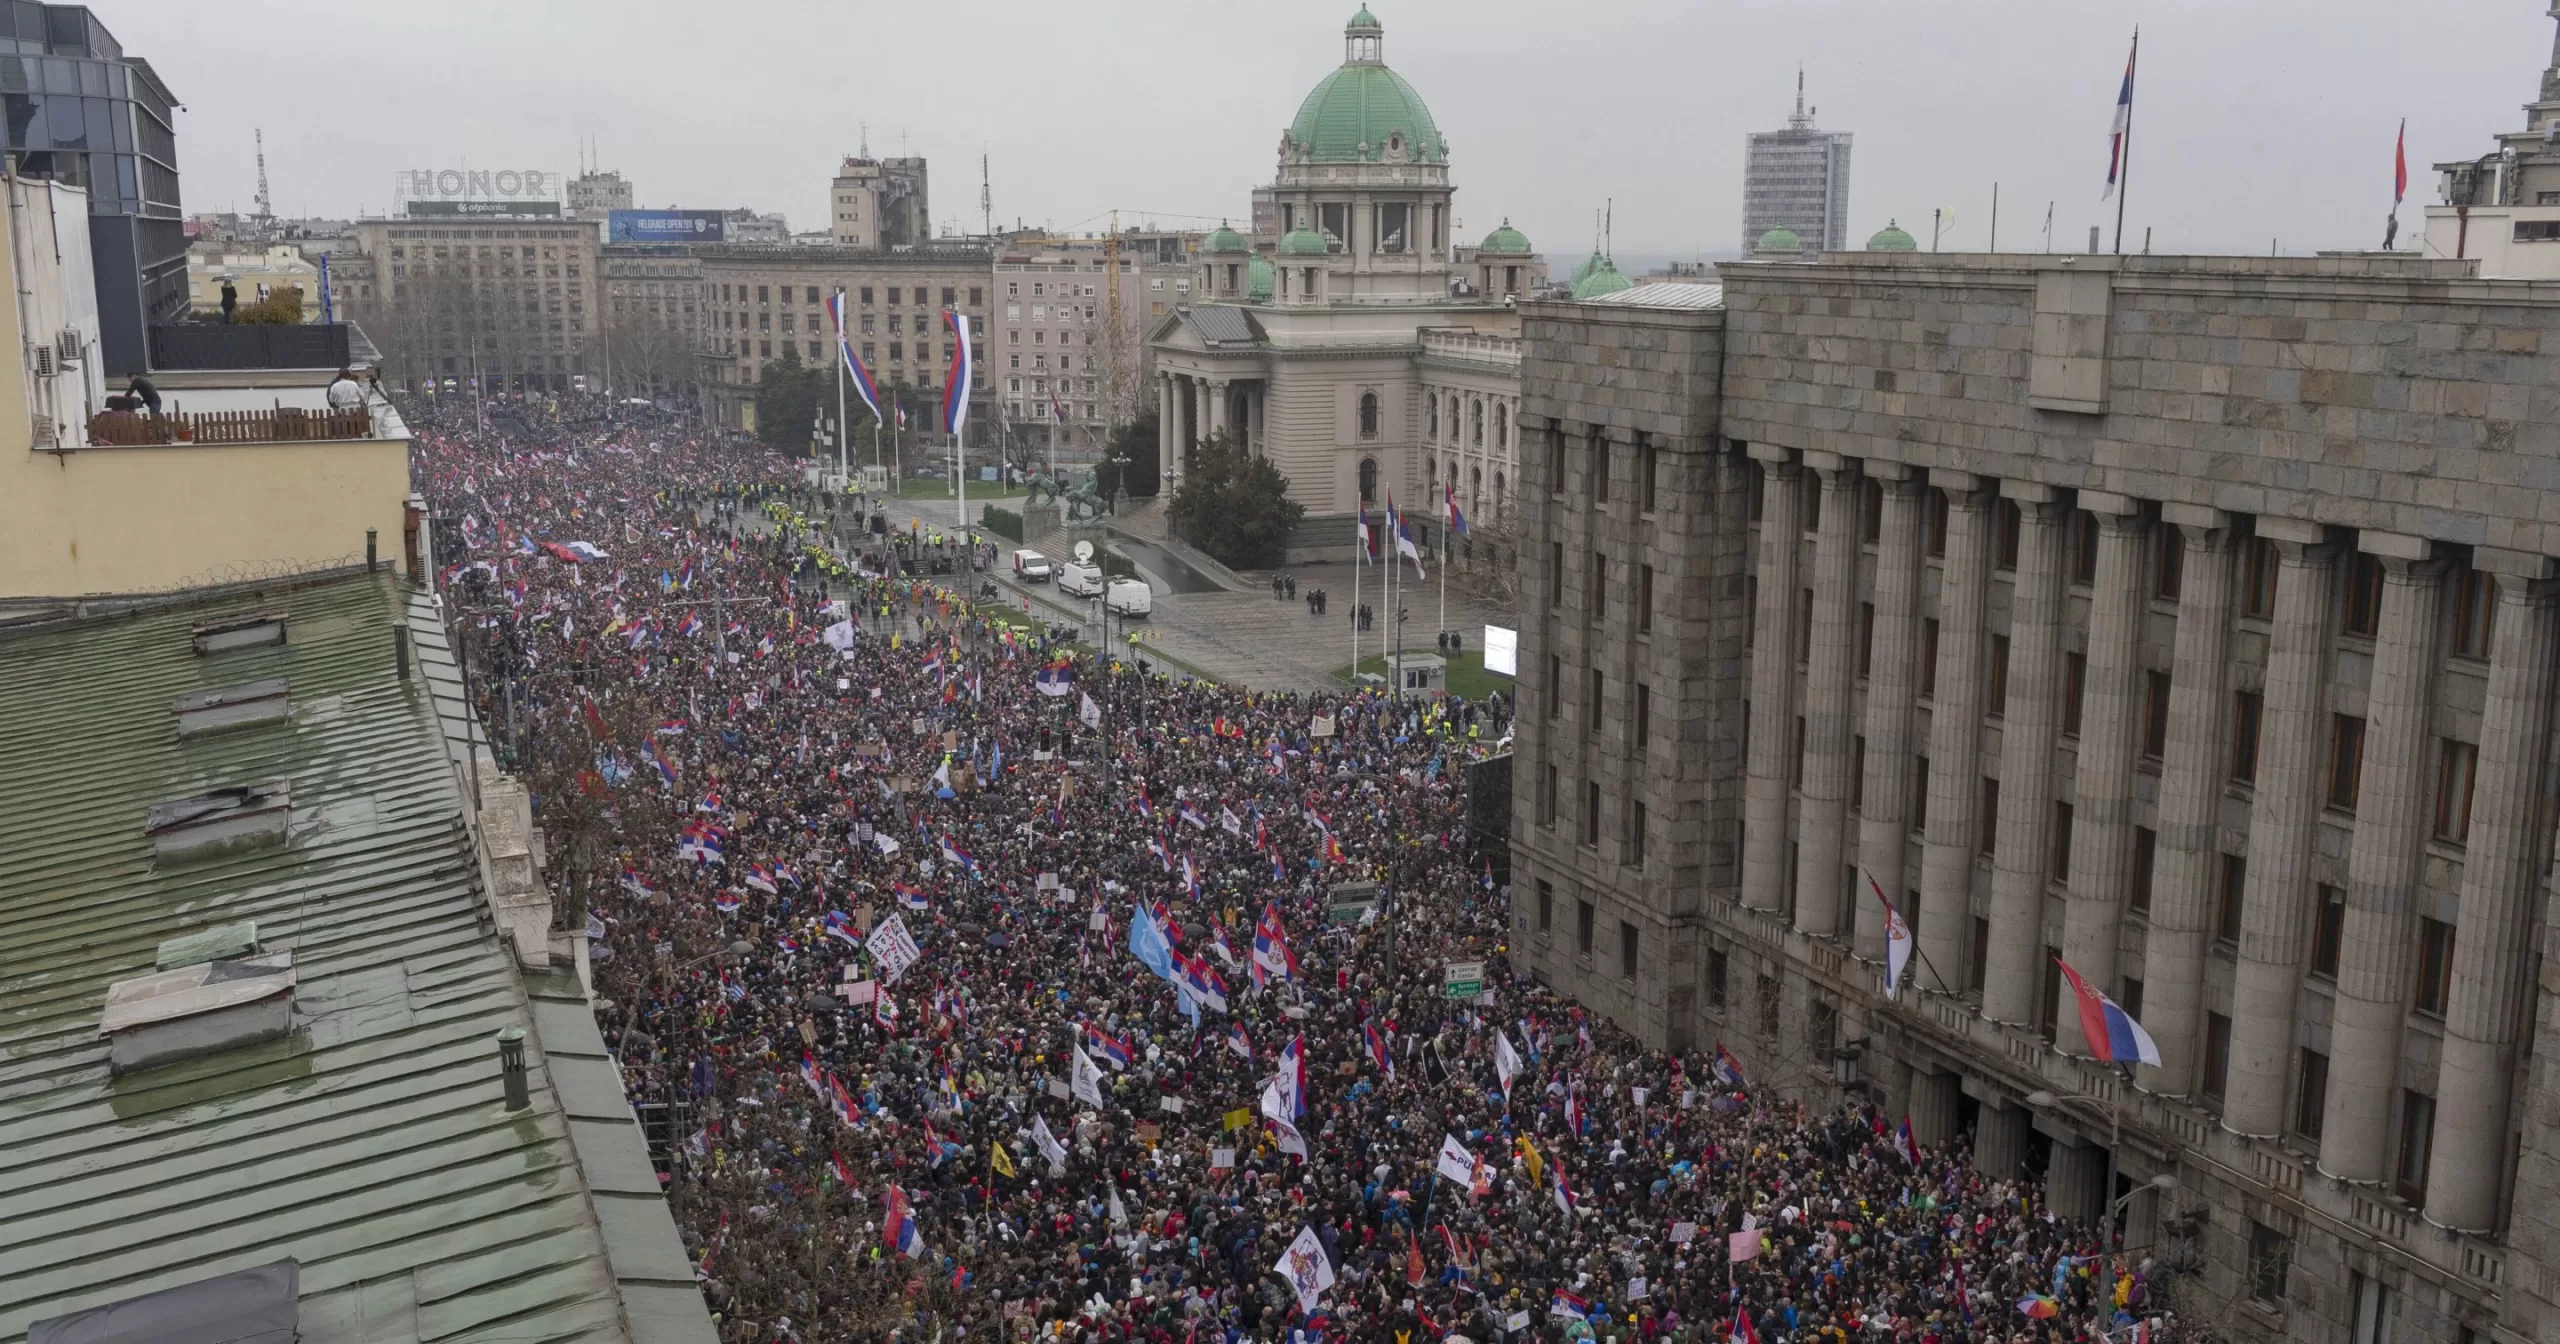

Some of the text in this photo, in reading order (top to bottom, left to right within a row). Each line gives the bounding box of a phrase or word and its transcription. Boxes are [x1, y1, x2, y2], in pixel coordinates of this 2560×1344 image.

[412, 169, 547, 196] HONOR
[469, 204, 507, 212] otpbanka
[1456, 1156, 1496, 1181] PUAJ
